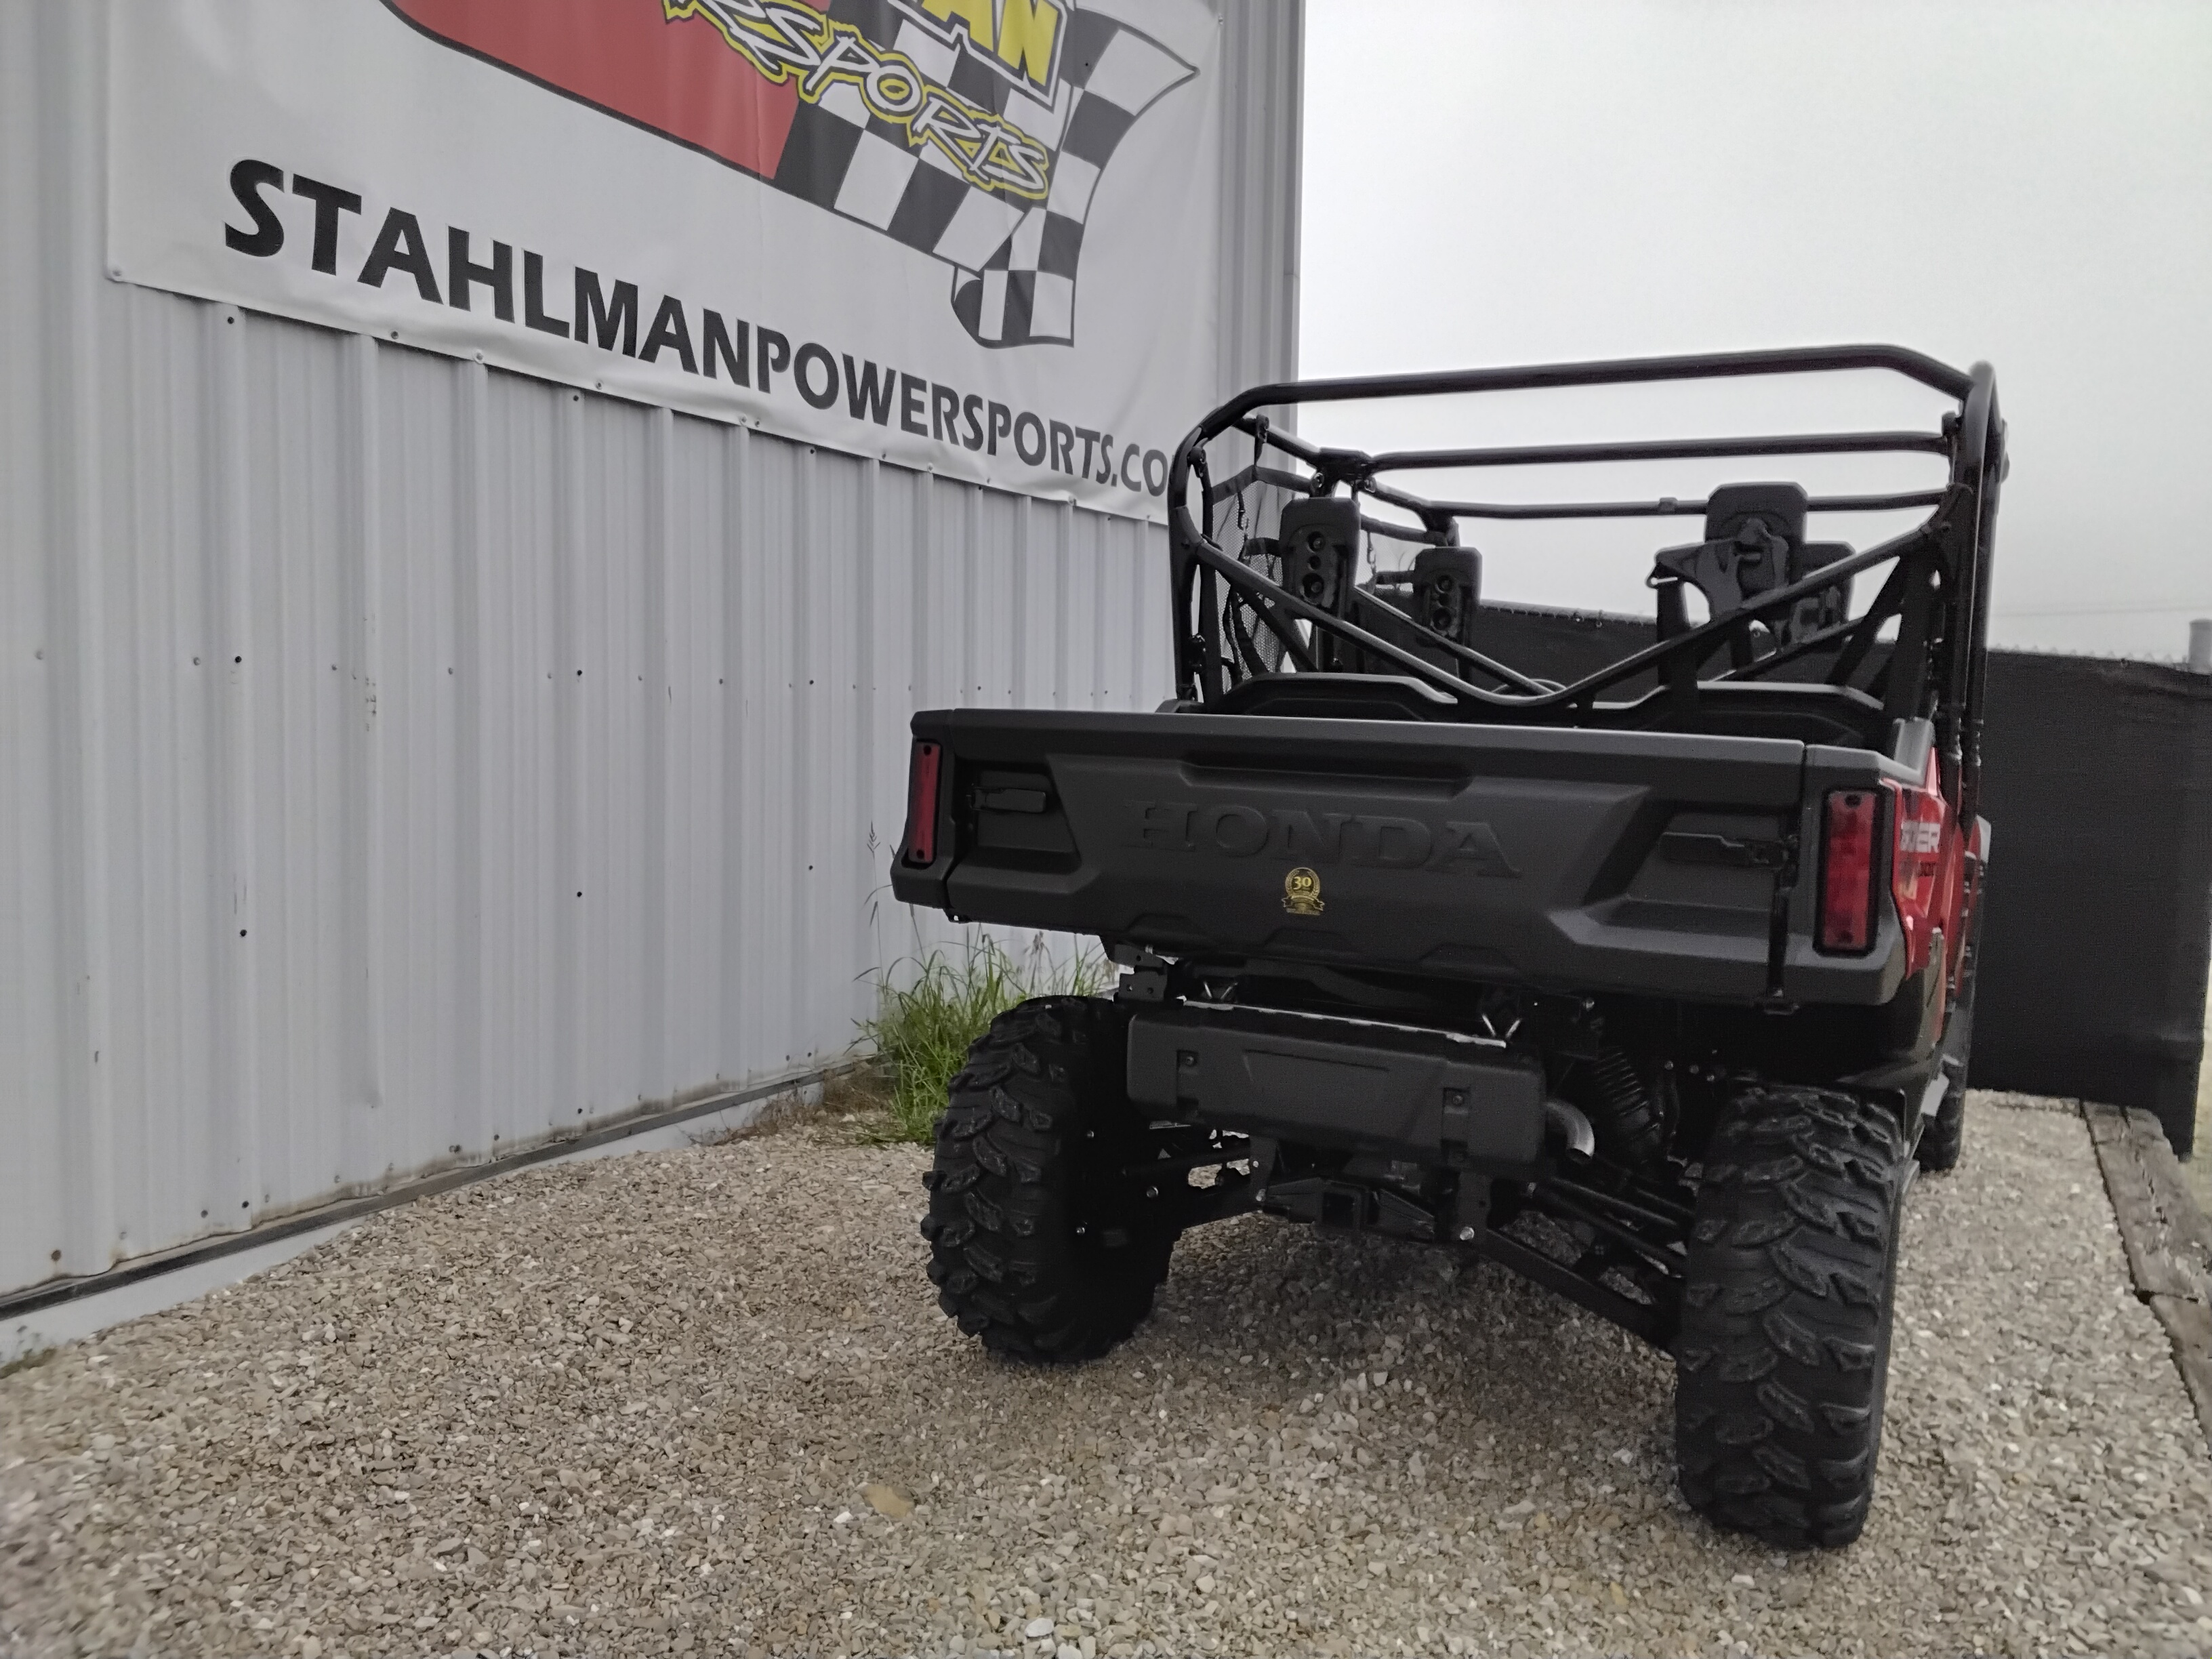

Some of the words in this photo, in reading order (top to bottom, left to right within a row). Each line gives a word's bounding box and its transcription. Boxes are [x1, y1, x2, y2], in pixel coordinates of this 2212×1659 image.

[224, 159, 1172, 497] STAHLMANPOWERSPORTS.CO
[1120, 798, 1522, 879] HONDA
[1292, 876, 1312, 890] 30
